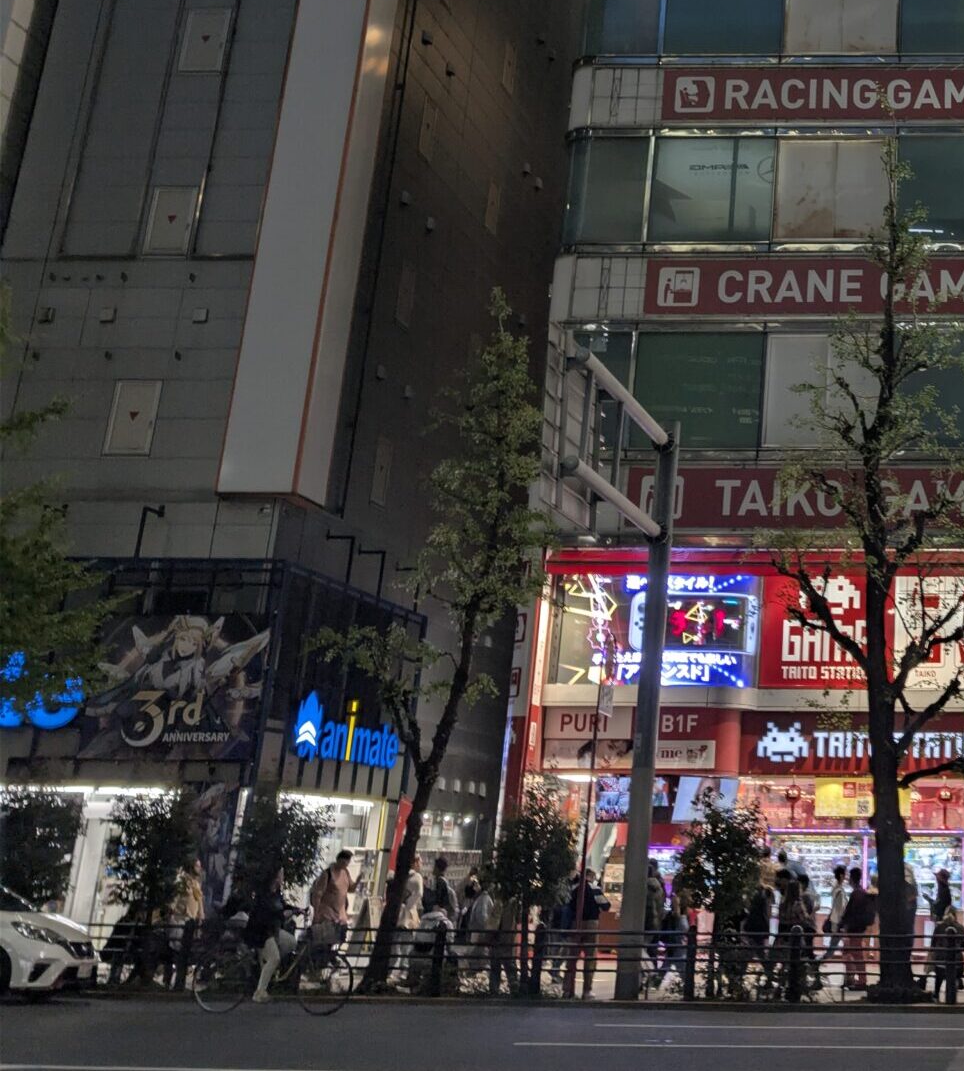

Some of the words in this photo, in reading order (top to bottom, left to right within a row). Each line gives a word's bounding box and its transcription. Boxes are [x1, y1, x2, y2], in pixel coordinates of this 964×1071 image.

[724, 78, 886, 111] RACING
[718, 268, 863, 304] CRANE
[782, 667, 817, 679] TAITO
[121, 690, 205, 747] 3rd
[560, 714, 607, 732] PURI
[662, 714, 698, 733] B1F
[162, 732, 230, 743] ANNIVERSARY
[319, 697, 400, 770] animate
